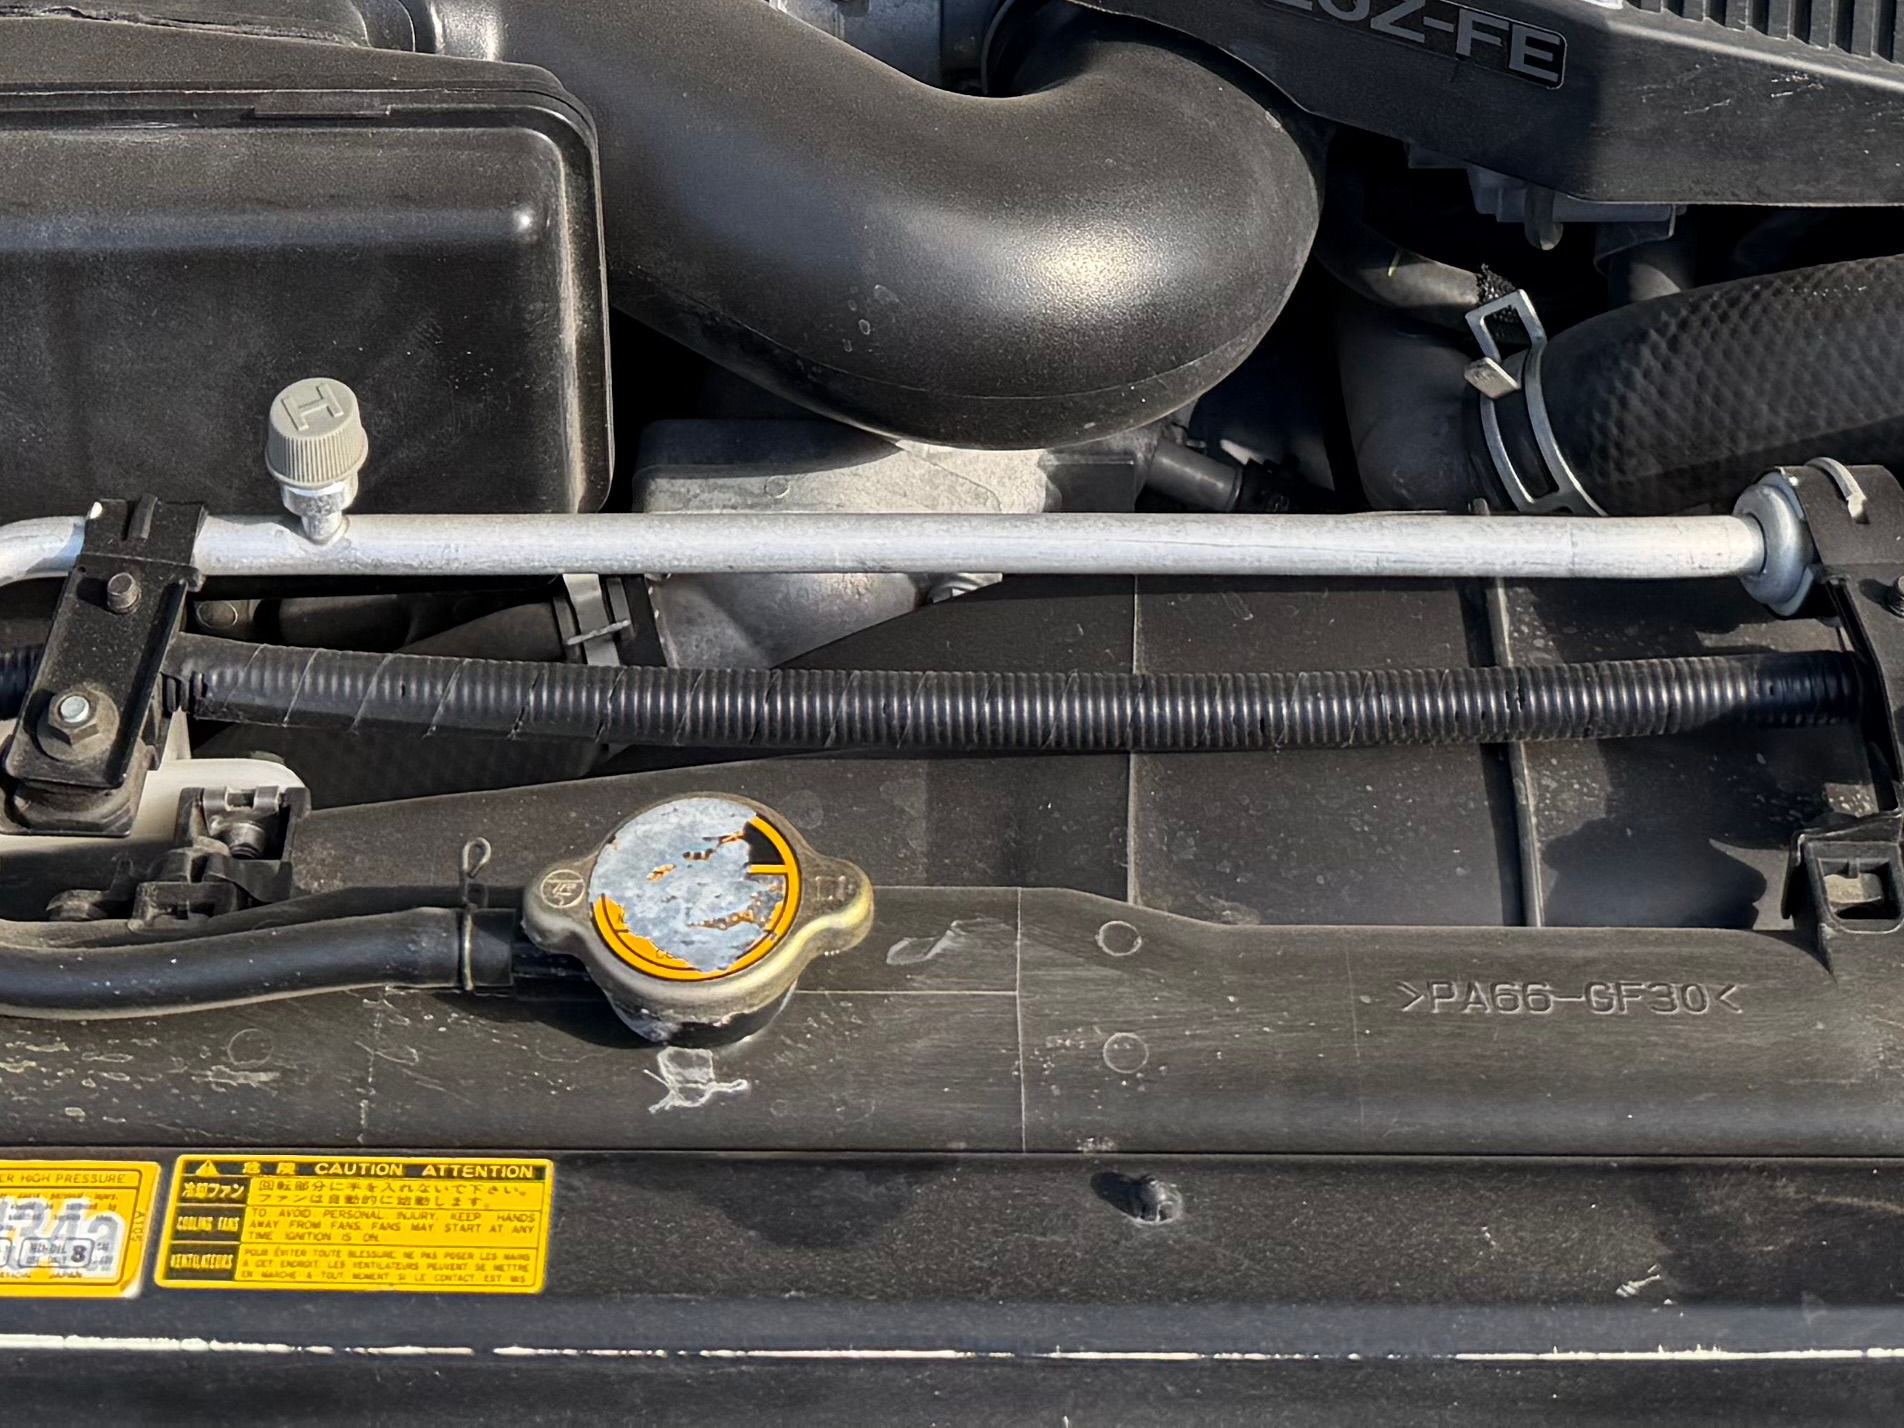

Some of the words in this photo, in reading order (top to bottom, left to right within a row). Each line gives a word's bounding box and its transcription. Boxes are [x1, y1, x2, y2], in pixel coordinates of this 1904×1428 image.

[283, 382, 346, 433] H
[1397, 980, 1743, 1016] >PA66-GF30<
[19, 1171, 51, 1183] HIGH
[55, 1171, 126, 1184] PRESSURE
[314, 1162, 404, 1176] CAUTION
[421, 1164, 534, 1178] ATTENTION
[182, 1182, 244, 1199] 冷却ファン
[253, 1208, 266, 1217] TO
[278, 1209, 311, 1218] AVOID
[322, 1208, 383, 1221] PERSONAL
[397, 1211, 439, 1221] INJURY.
[450, 1212, 482, 1221] KEEP
[496, 1213, 536, 1223] HANDS
[176, 1216, 214, 1231] COOLING
[218, 1216, 240, 1232] FANS
[250, 1220, 279, 1229] AWAY
[289, 1220, 321, 1229] FROM
[371, 1222, 401, 1231] FANS
[411, 1222, 434, 1231] MAY
[445, 1223, 482, 1232] START
[488, 1224, 504, 1233] AT
[512, 1224, 535, 1234] ANY
[249, 1231, 272, 1240] TIME
[285, 1231, 332, 1241] IGNITION
[342, 1232, 352, 1241] IS
[70, 1244, 86, 1262] 8
[244, 1248, 269, 1256] POUR
[313, 1249, 341, 1257] TOUTE
[420, 1252, 437, 1260] PAS
[444, 1252, 474, 1260] POSER
[503, 1253, 530, 1261] MAINS
[170, 1254, 233, 1269] VENTILATEURS
[255, 1260, 273, 1268] CET
[328, 1260, 345, 1269] LES
[352, 1260, 419, 1271] VENTILATEURS
[426, 1262, 468, 1271] PEUVENT
[474, 1263, 487, 1272] SE
[493, 1263, 530, 1272] METTRE
[241, 1270, 253, 1278] EN
[261, 1270, 297, 1279] MARCHE
[434, 1274, 475, 1282] CONTACT
[484, 1274, 503, 1282] EST
